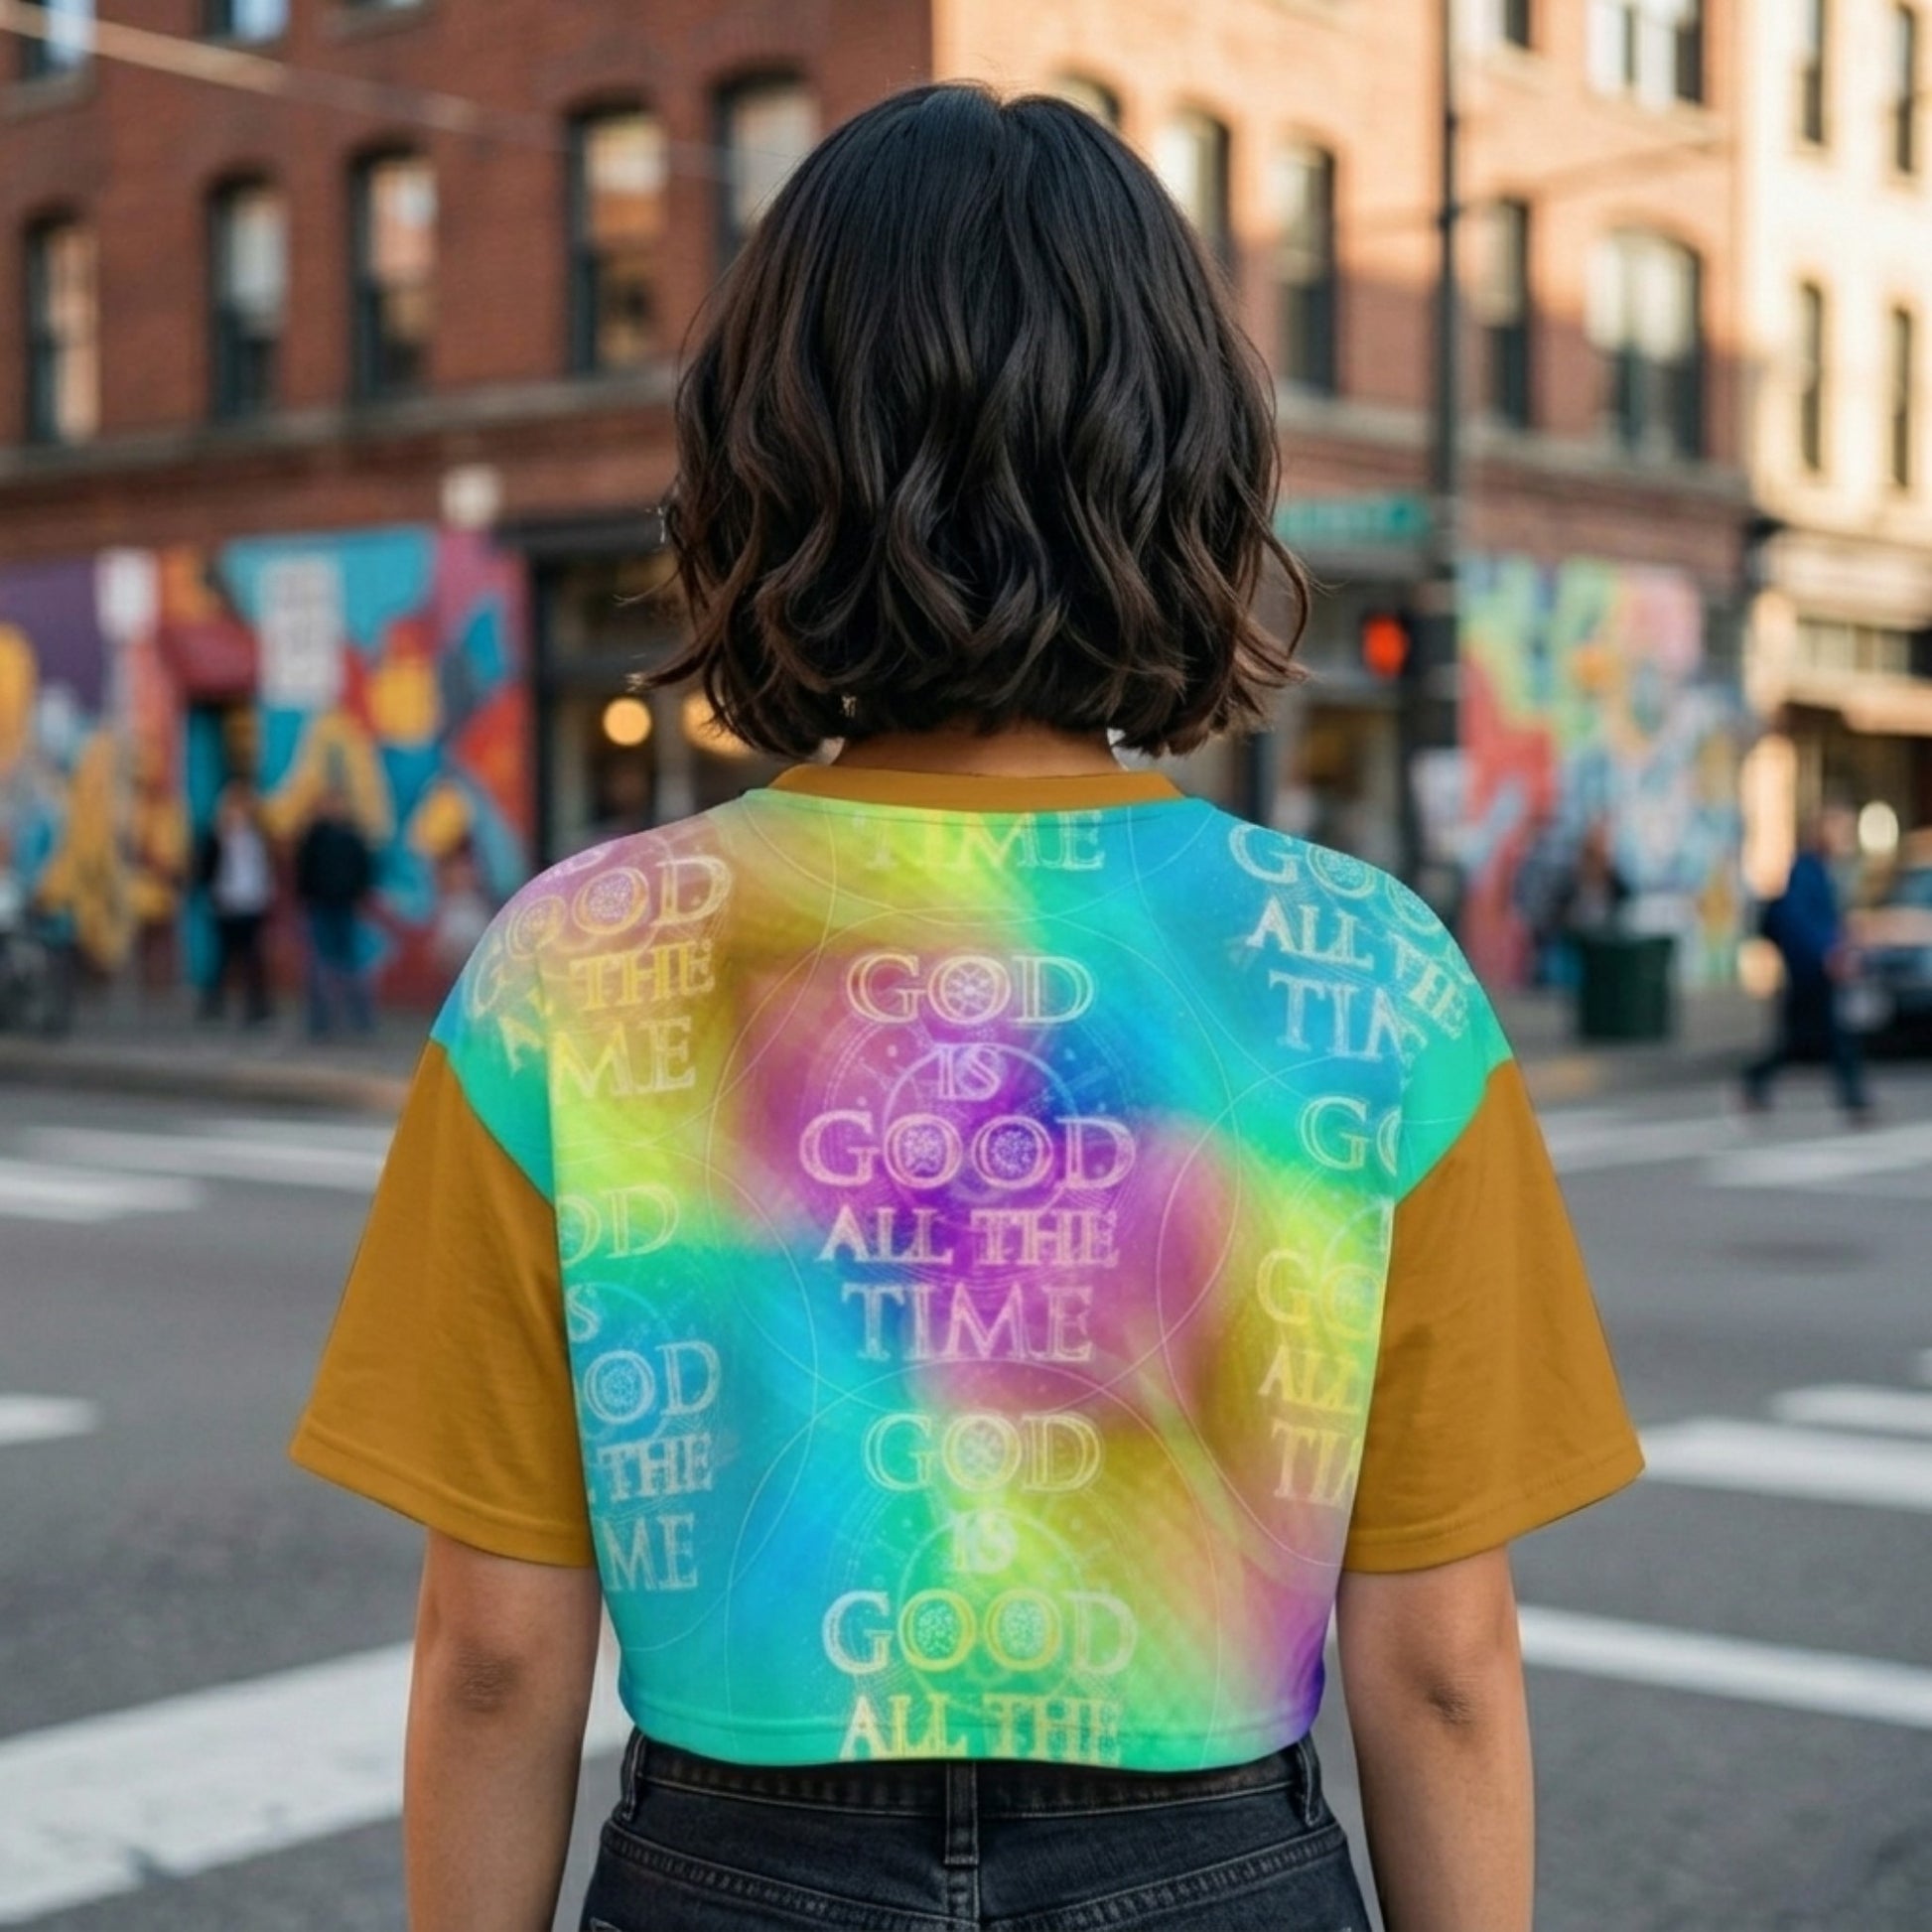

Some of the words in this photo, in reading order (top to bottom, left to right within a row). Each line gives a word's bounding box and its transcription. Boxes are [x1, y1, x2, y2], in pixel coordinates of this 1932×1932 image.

[1245, 896, 1374, 971] ALL
[572, 939, 715, 1012] THE
[846, 950, 1095, 1027] GOD
[937, 1042, 1003, 1101] IS
[798, 1109, 1138, 1190] GOOD
[559, 1183, 677, 1264] OD
[814, 1204, 955, 1265] ALL
[969, 1206, 1120, 1269] THE
[841, 1281, 1093, 1362] TIME
[583, 1339, 722, 1424] OD
[598, 1432, 715, 1502] THE
[864, 1413, 1102, 1493] GOD
[600, 1512, 698, 1593] ME
[821, 1588, 1139, 1676] GOOD
[839, 1693, 969, 1761] ALL
[981, 1692, 1122, 1767] THE
